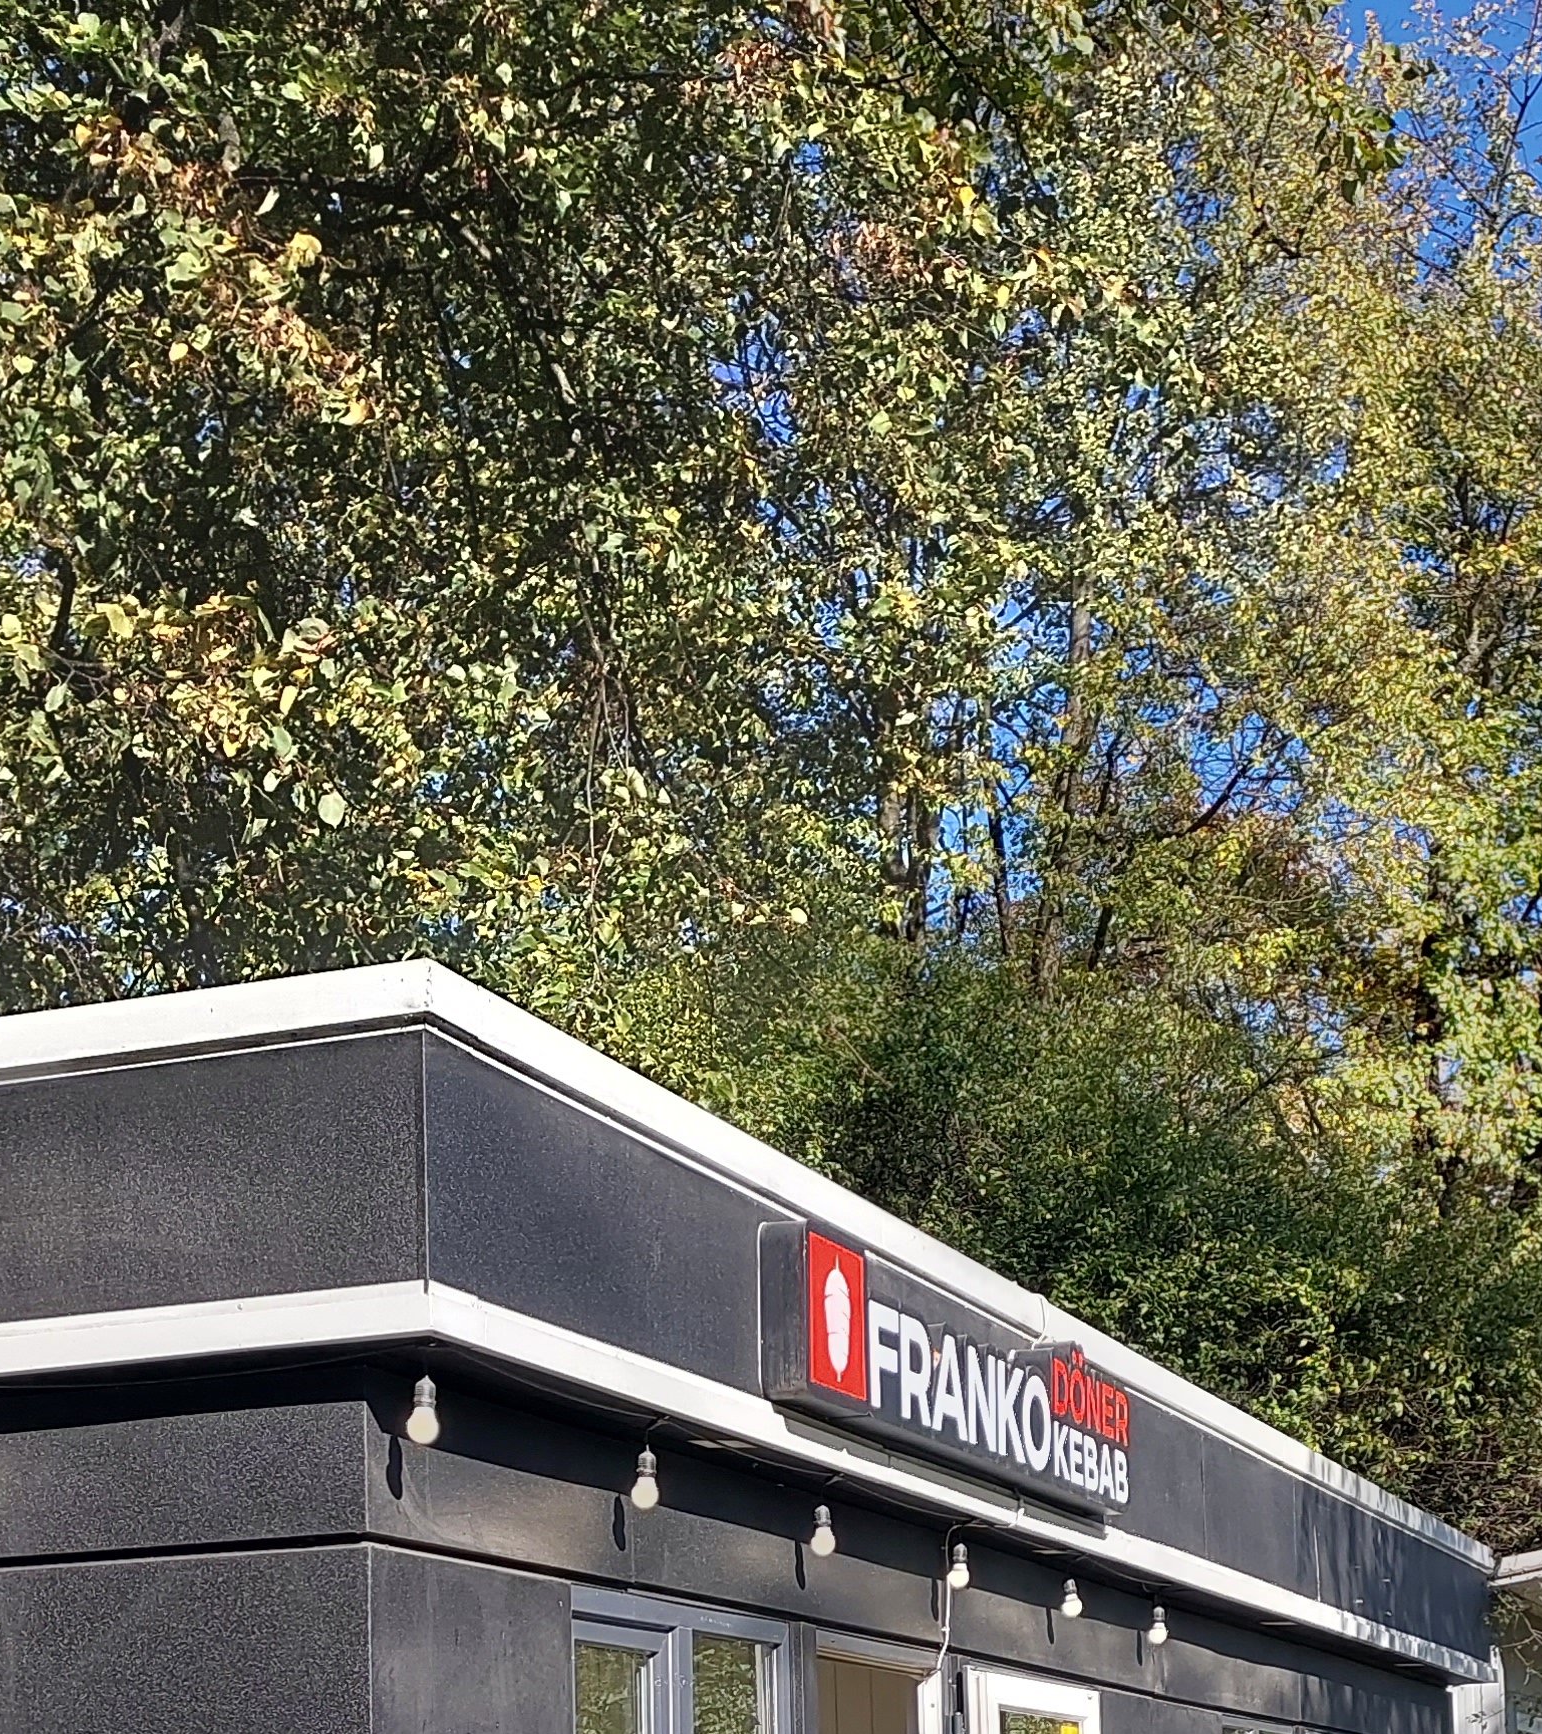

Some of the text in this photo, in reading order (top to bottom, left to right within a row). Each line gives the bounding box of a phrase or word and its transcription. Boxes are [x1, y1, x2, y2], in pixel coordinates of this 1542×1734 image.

[865, 1299, 1052, 1472] FRANKO
[1051, 1351, 1130, 1448] DÖNER
[1052, 1423, 1130, 1504] KEBAB
